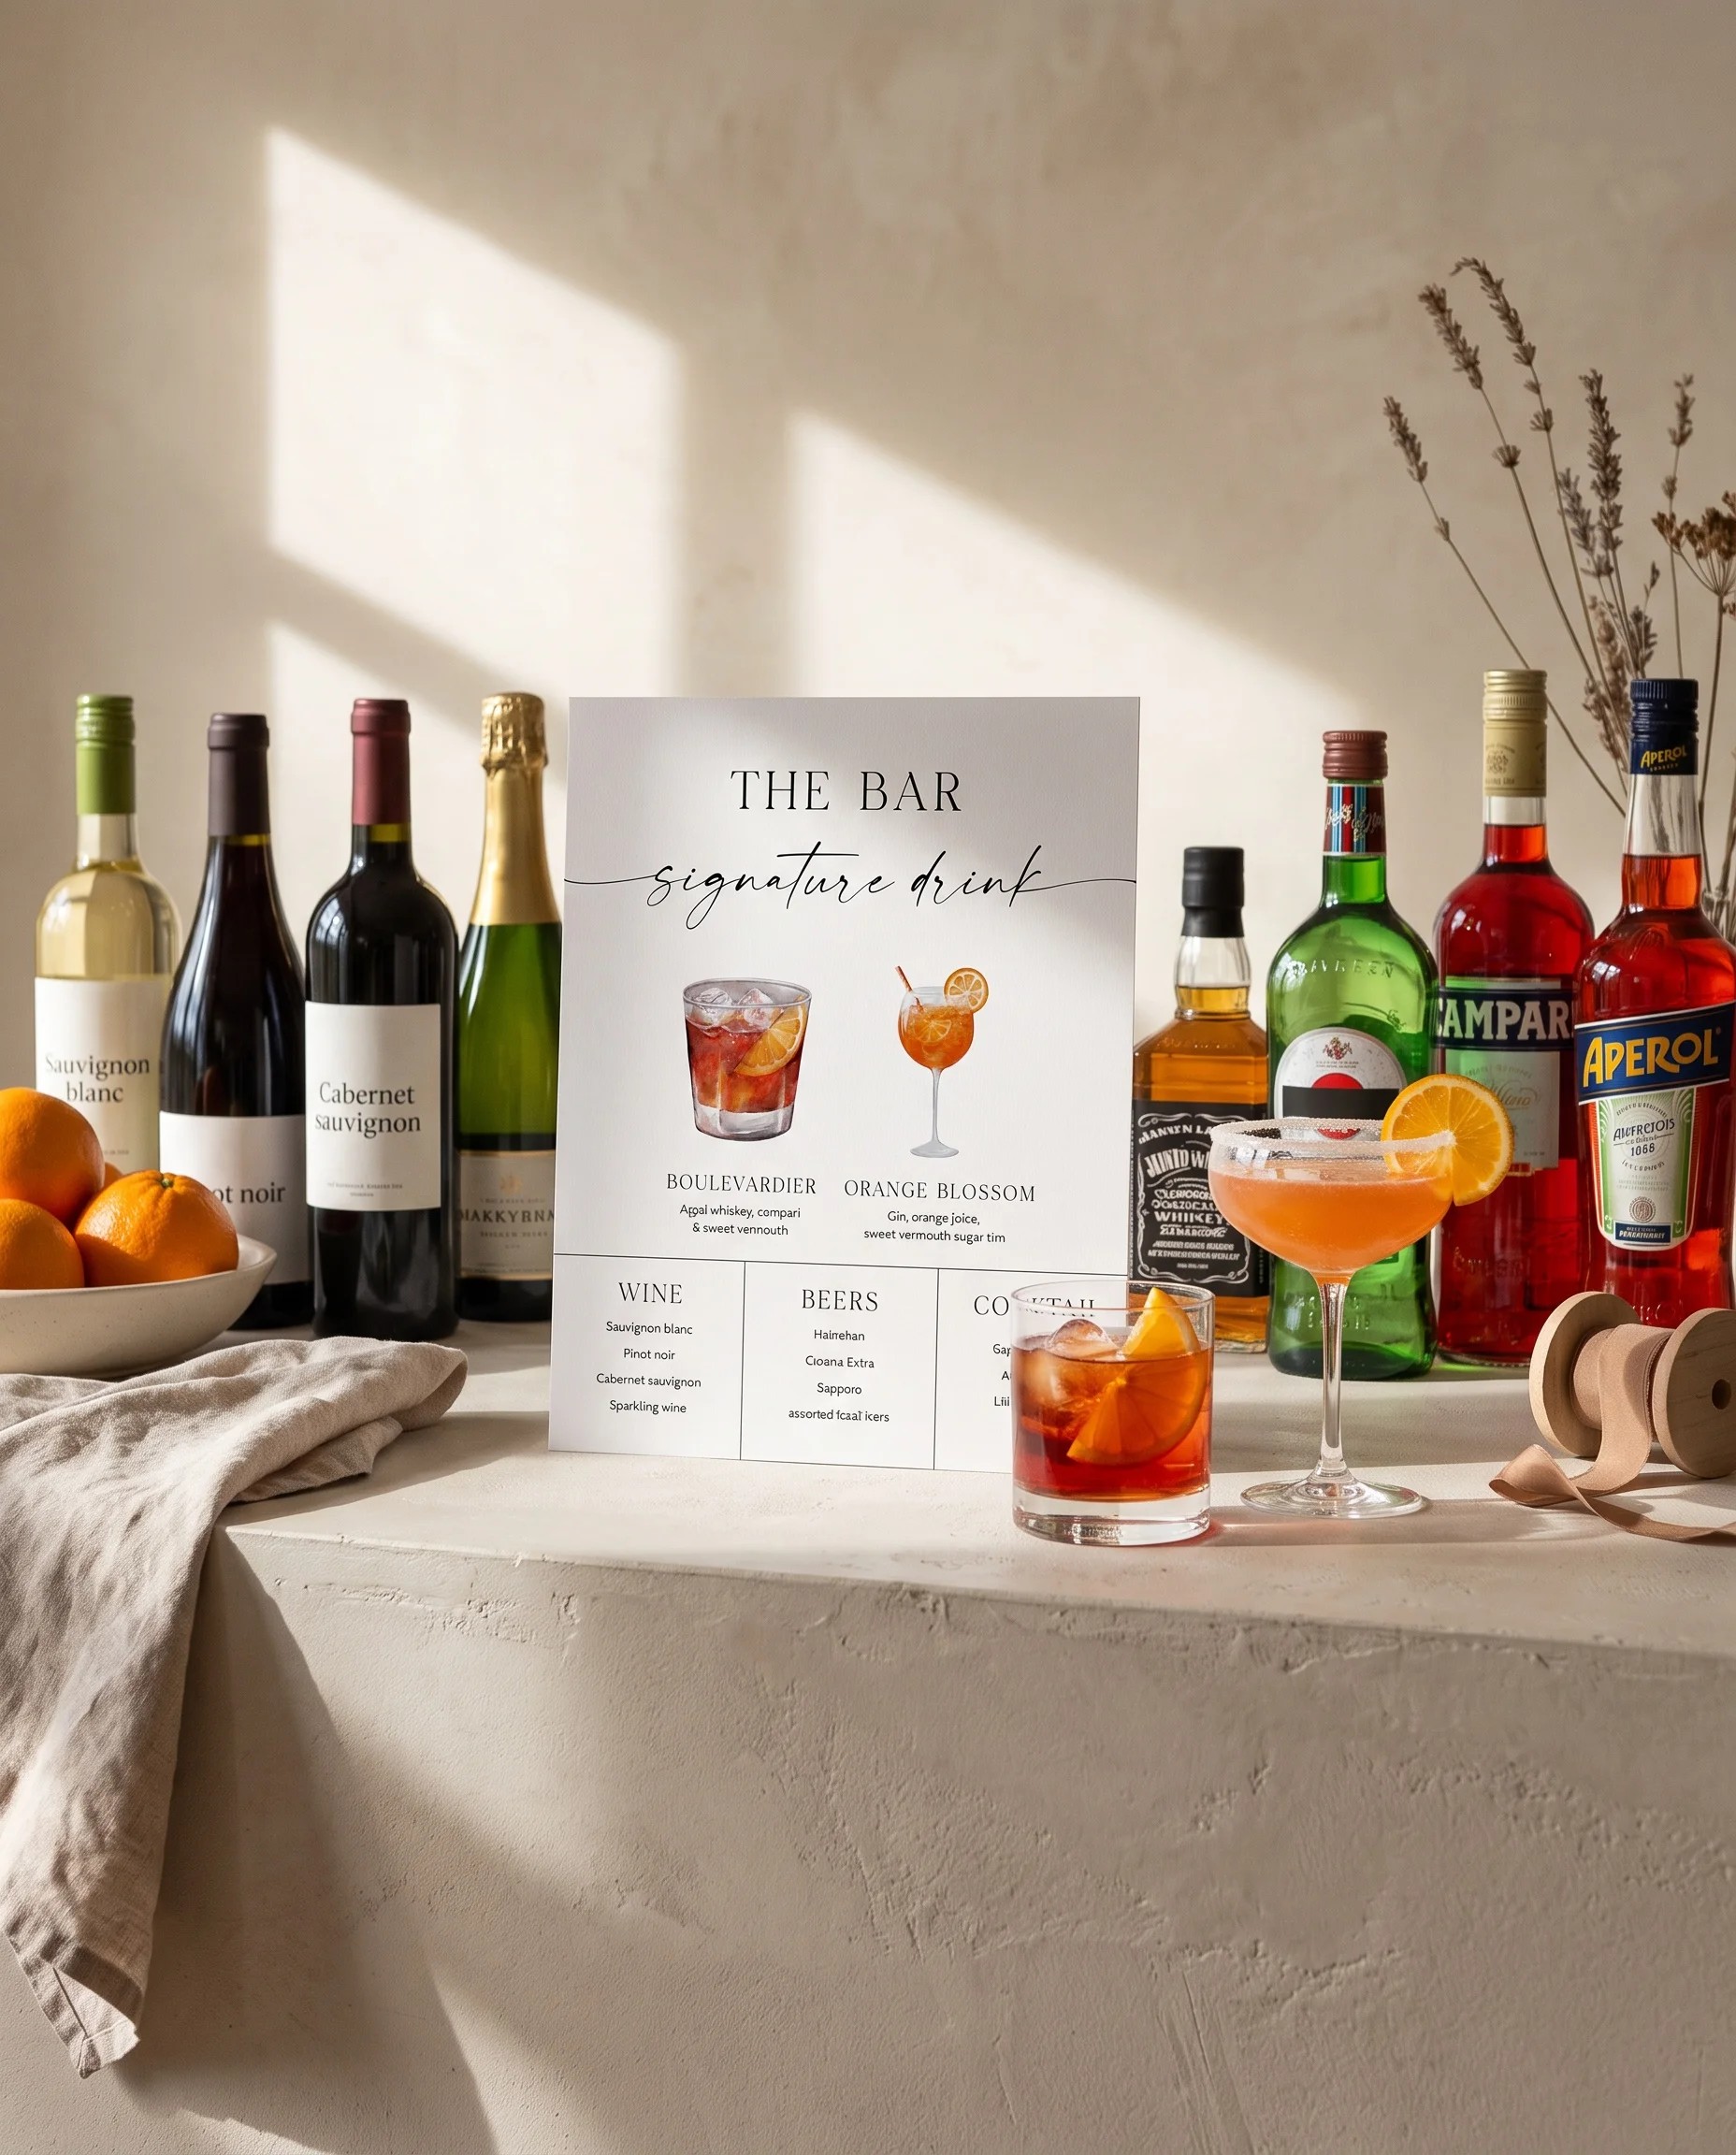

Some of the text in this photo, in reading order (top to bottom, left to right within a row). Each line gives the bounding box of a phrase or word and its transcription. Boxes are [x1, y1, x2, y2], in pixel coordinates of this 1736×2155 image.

[731, 770, 962, 813] THE BAR
[564, 842, 1136, 930] signature drink
[1438, 997, 1574, 1041] AMPAR
[45, 1055, 151, 1080] Sauvignon
[1583, 1029, 1719, 1089] APEROL
[65, 1082, 123, 1103] blanc
[319, 1081, 415, 1105] Cabernet
[315, 1112, 421, 1139] sauvignon
[240, 1182, 286, 1204] noir
[667, 1173, 817, 1194] BOULEVARDIER
[844, 1179, 1035, 1202] ORANGE BLOSSOM
[710, 1205, 754, 1219] whiskey,
[888, 1210, 980, 1226] Gin, orange joice,
[692, 1222, 701, 1233] &
[703, 1223, 734, 1234] sweet
[863, 1229, 1005, 1245] sweet vermouth sugar tim
[618, 1282, 683, 1304] WINE
[802, 1289, 878, 1311] BEERS
[606, 1321, 693, 1336] Sauvignon blanc
[623, 1348, 675, 1360] Pinot noir
[846, 1356, 875, 1368] Extra
[596, 1373, 702, 1390] Cabernet sauvignon
[817, 1382, 862, 1396] Sapporo
[609, 1400, 687, 1415] Sparkling wine
[788, 1409, 833, 1420] assorted
